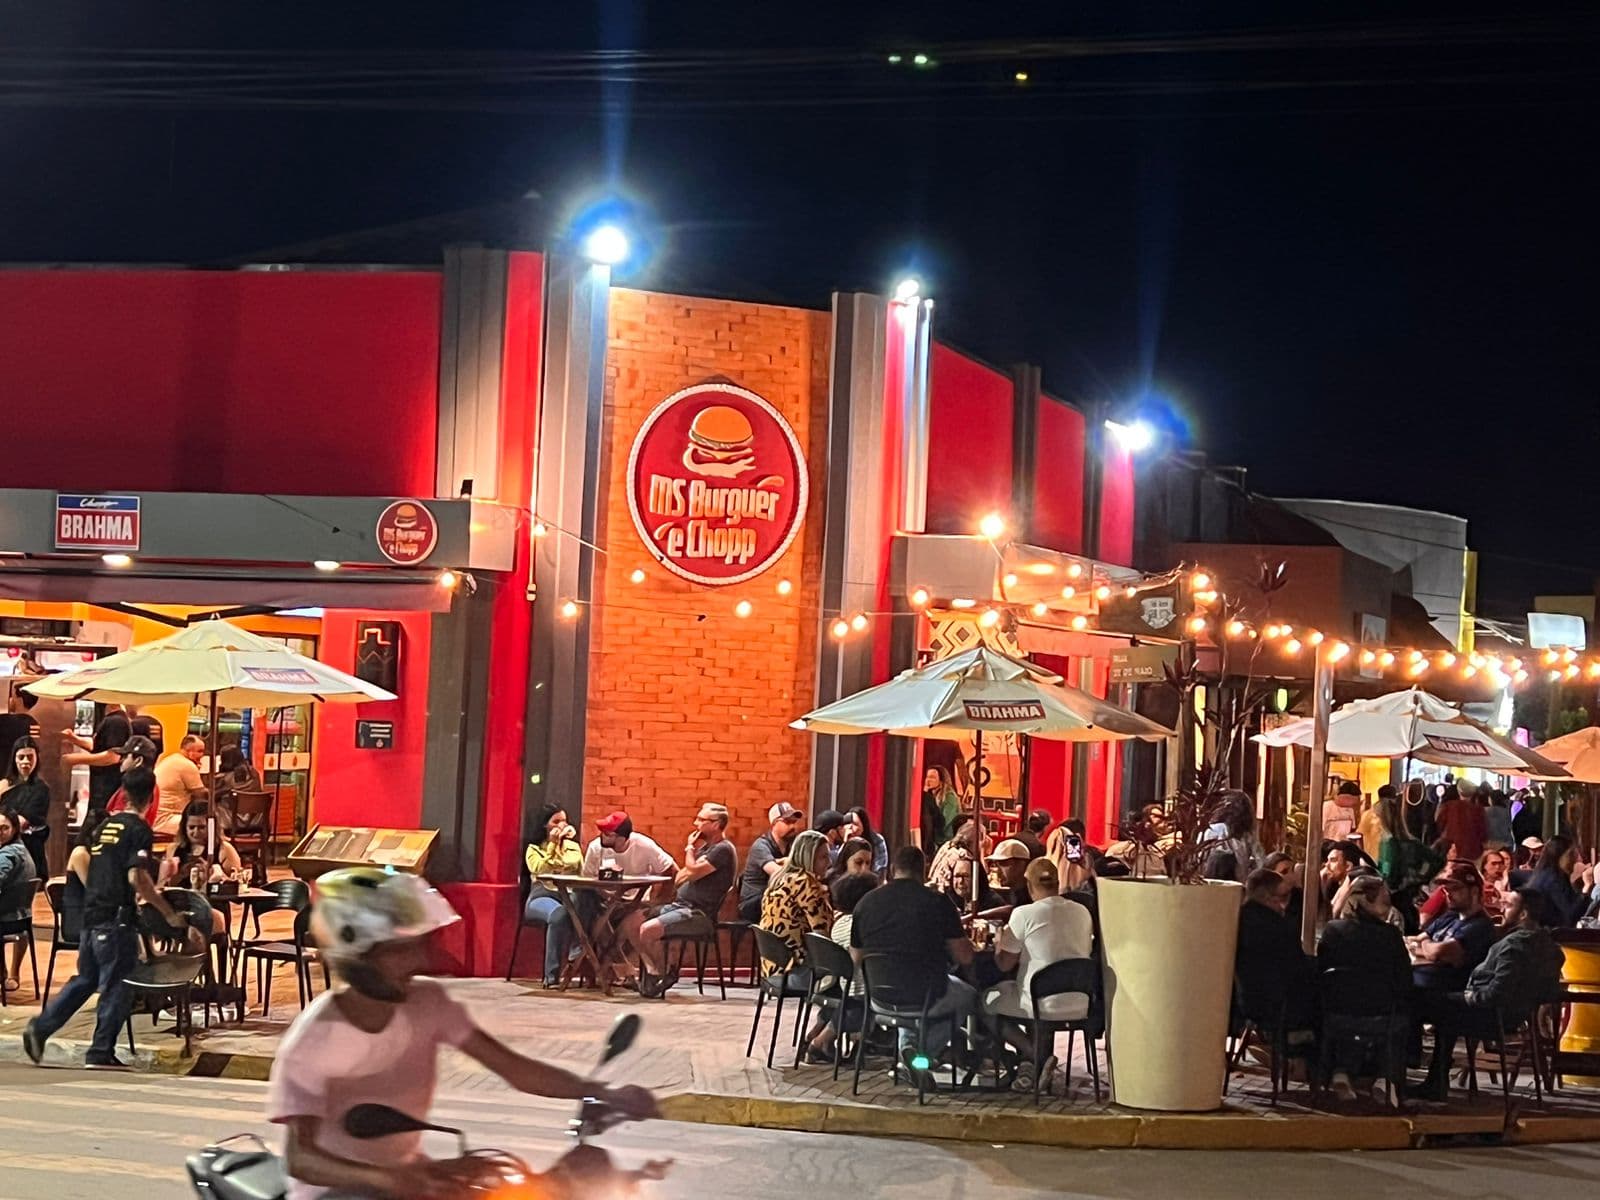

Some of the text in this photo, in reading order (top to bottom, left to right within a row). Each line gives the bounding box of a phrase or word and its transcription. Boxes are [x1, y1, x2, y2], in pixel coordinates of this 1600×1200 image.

[649, 474, 780, 525] MS Burguer
[61, 514, 133, 540] BRAHMA
[667, 520, 756, 565] e Chopp
[967, 705, 1042, 719] BRAHMA
